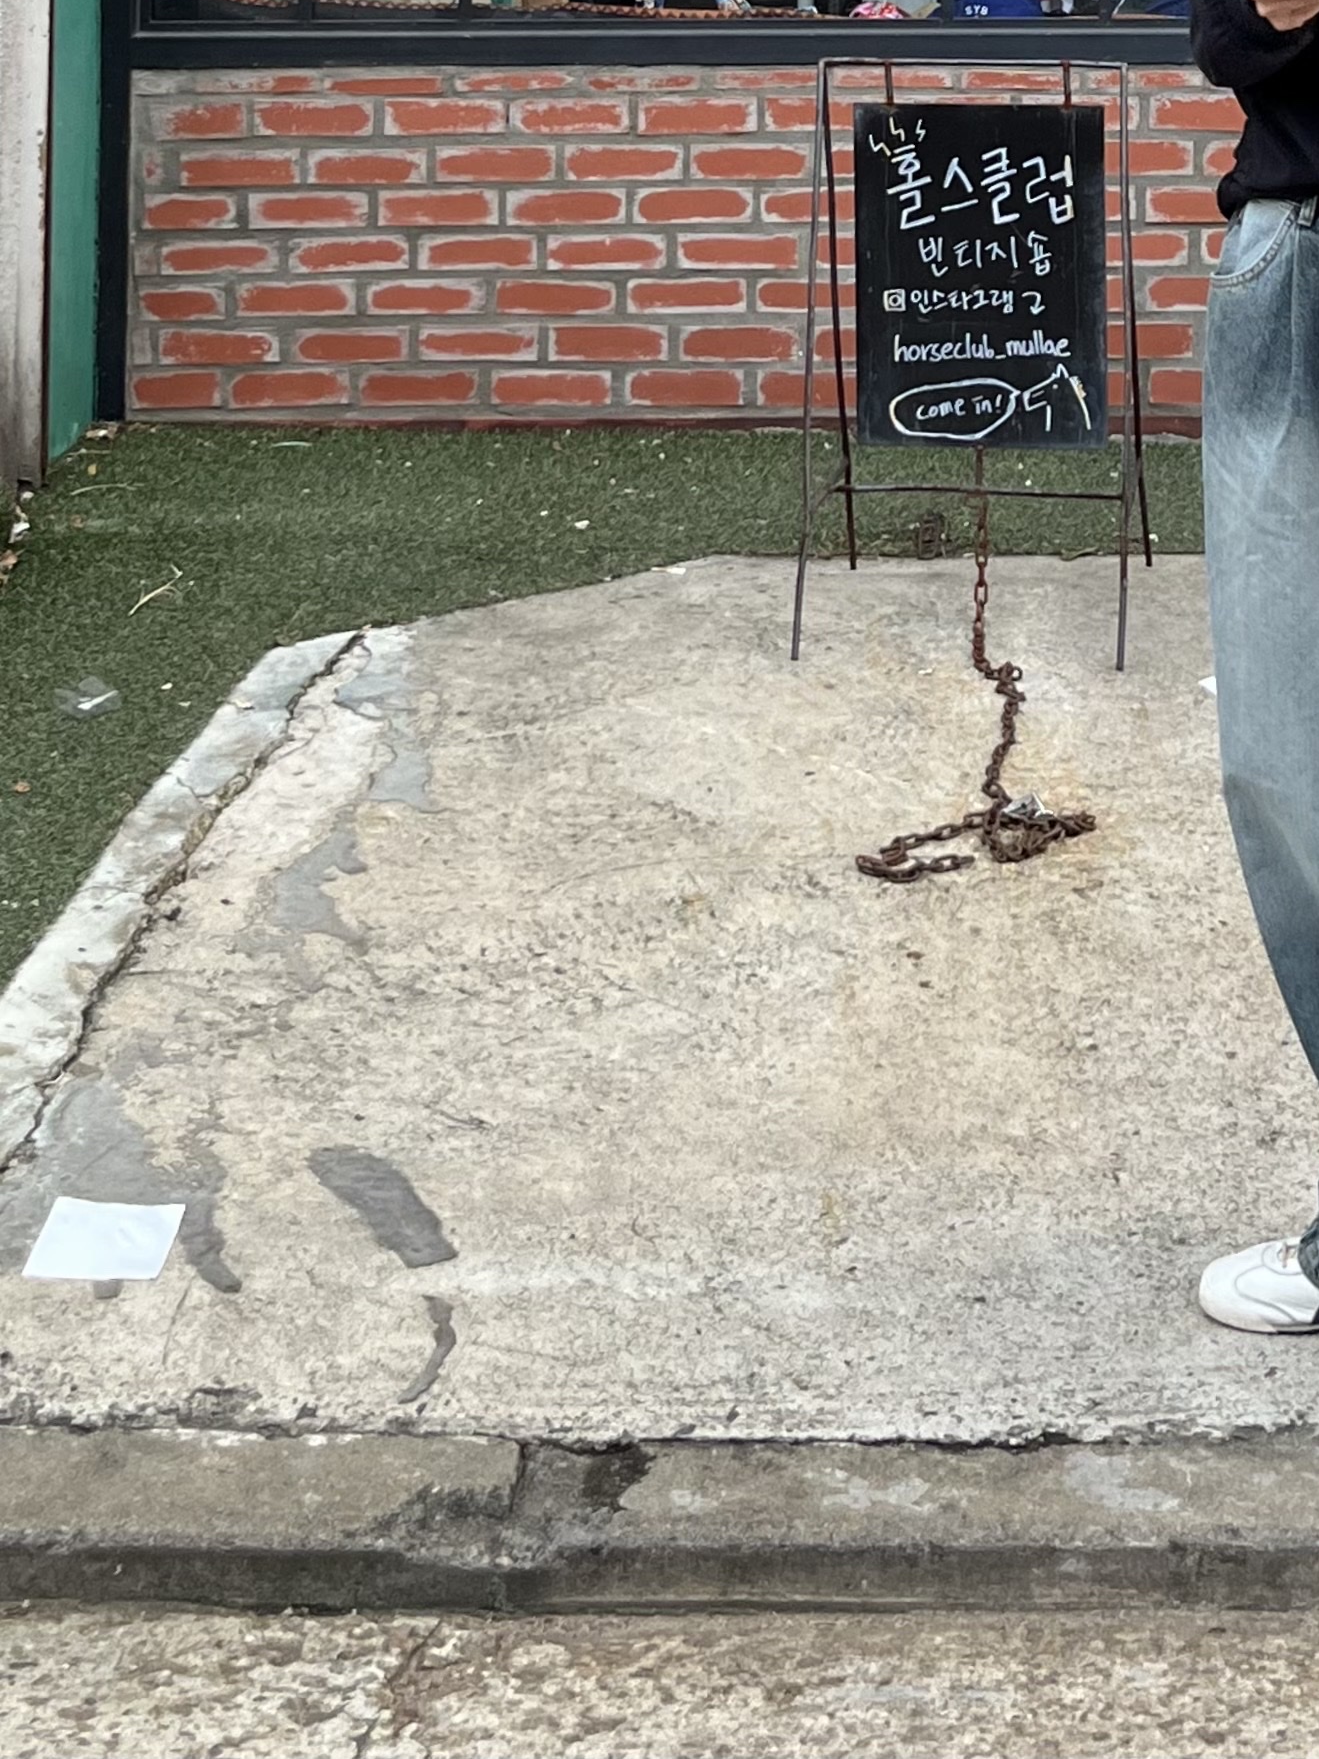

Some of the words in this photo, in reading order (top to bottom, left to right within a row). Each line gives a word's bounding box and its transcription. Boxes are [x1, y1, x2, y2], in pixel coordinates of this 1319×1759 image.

[886, 144, 1075, 230] 홀스클럽
[910, 289, 1014, 314] 인스타그램
[894, 329, 1072, 363] horseclub_mullae
[916, 398, 966, 420] come
